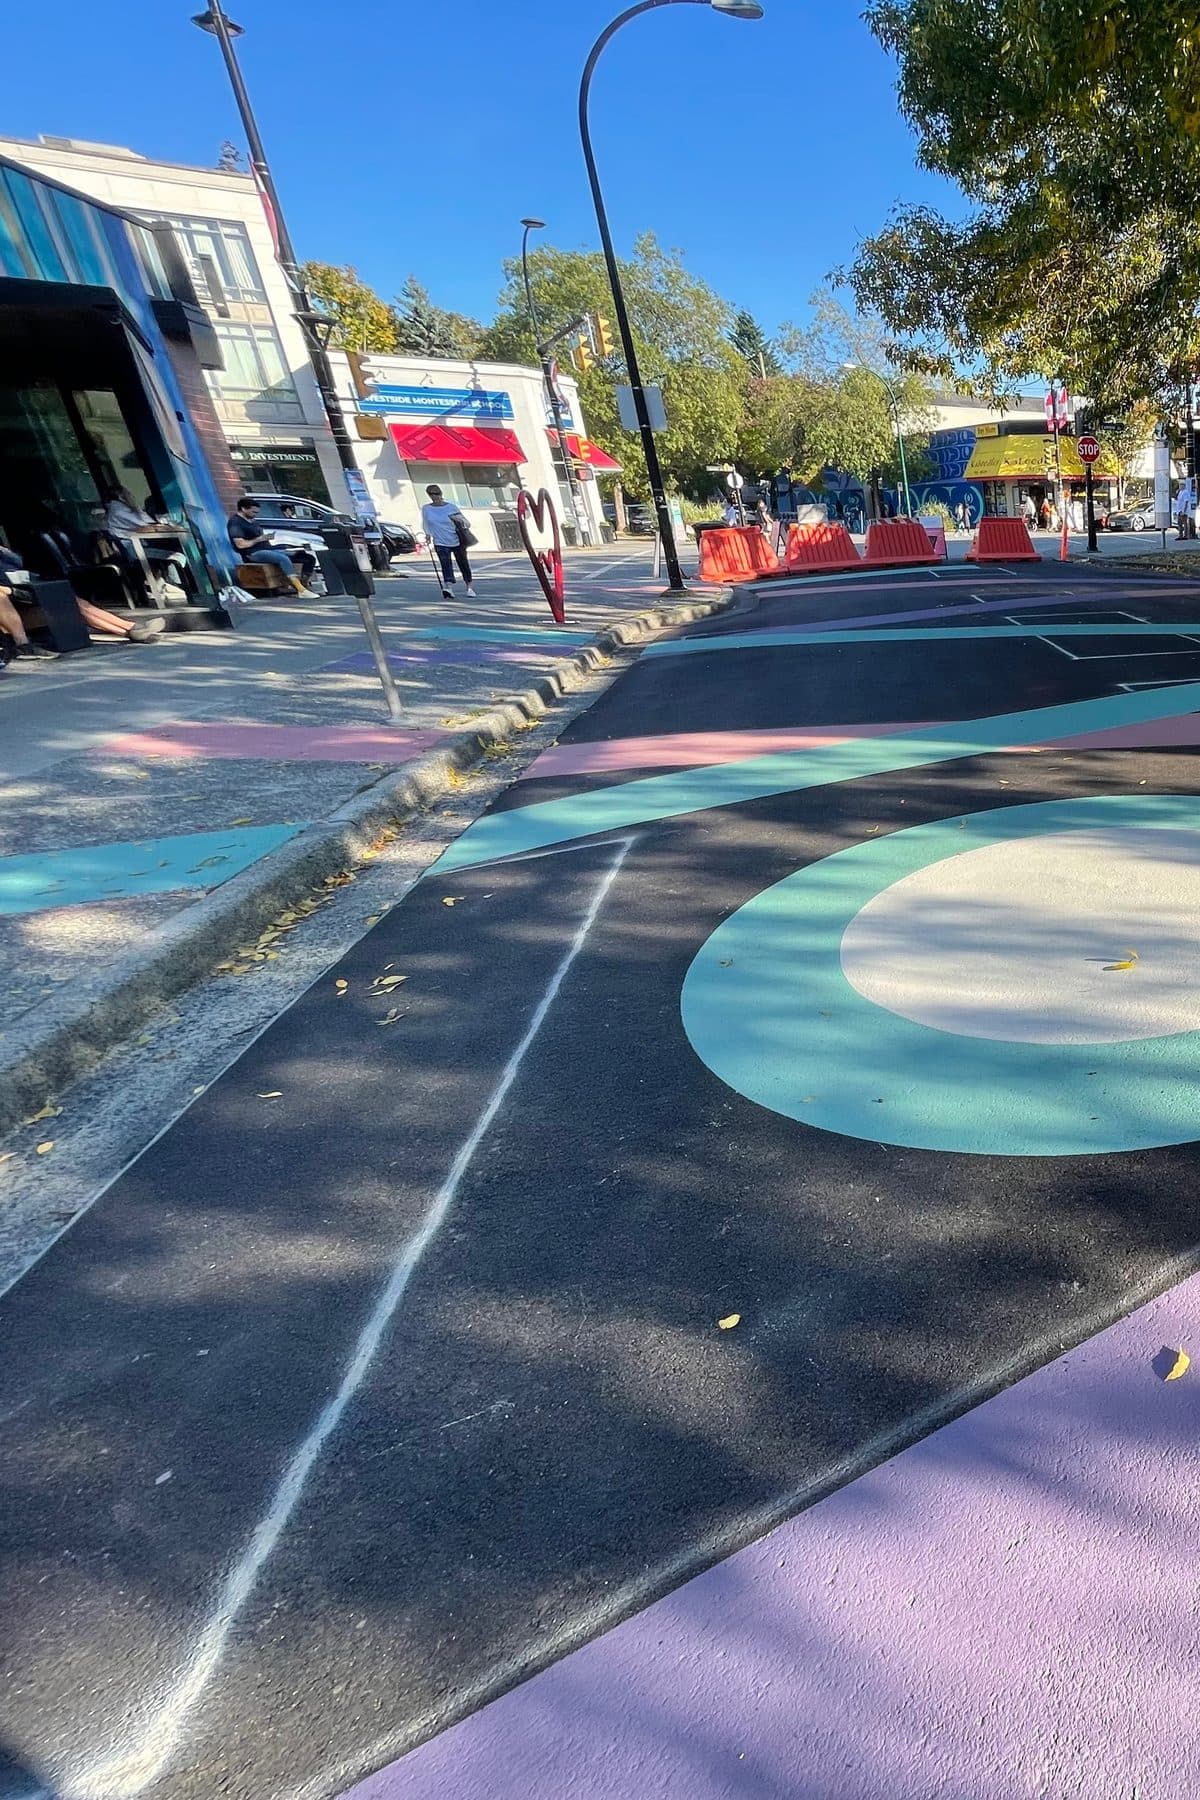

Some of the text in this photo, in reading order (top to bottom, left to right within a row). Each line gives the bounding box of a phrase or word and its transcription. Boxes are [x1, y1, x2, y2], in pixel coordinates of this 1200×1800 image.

[412, 397, 470, 407] MONTESSORI
[471, 399, 507, 409] SCHOOL
[1078, 444, 1099, 454] STOP
[249, 452, 316, 462] INVESTMENTS
